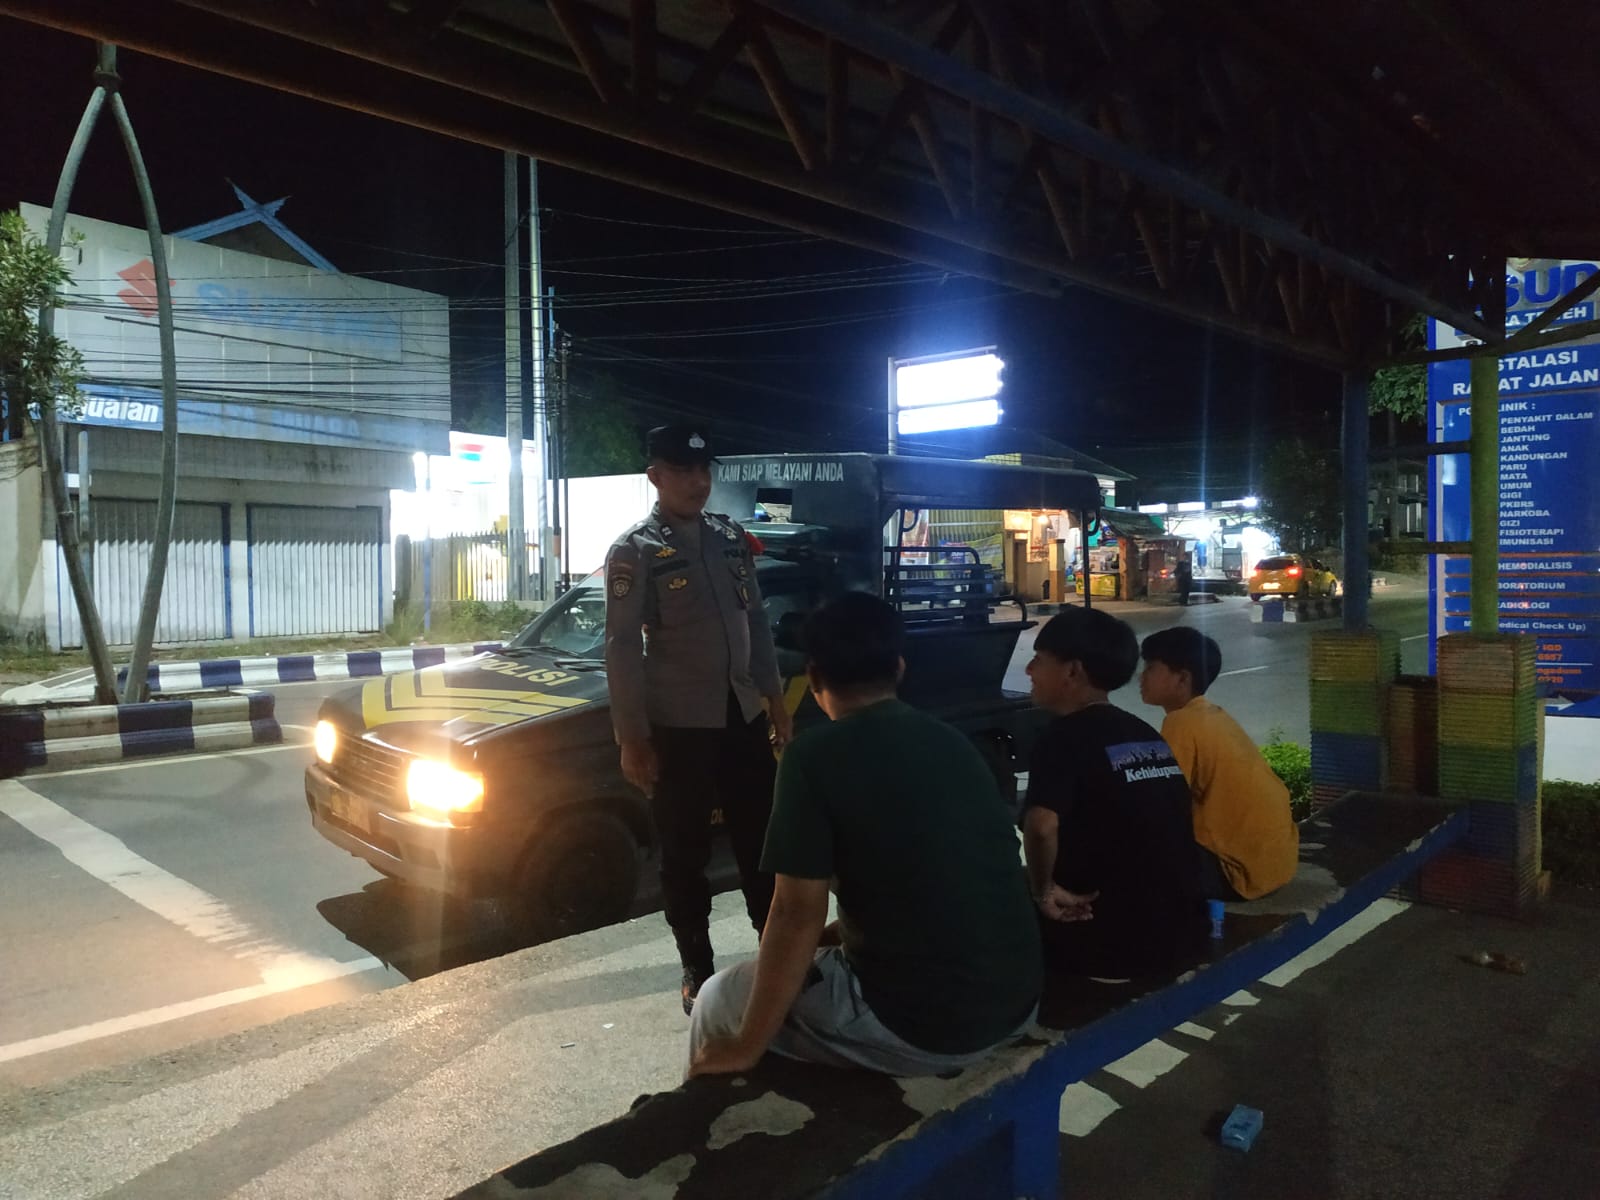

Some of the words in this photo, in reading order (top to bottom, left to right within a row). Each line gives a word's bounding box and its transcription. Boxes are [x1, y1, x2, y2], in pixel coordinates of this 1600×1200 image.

[1498, 350, 1579, 372] STALASI
[1528, 368, 1599, 389] JALAN
[1500, 414, 1552, 424] PENYAKIT
[1555, 412, 1593, 421] DALAM
[1500, 425, 1536, 434] BEDAH
[1500, 434, 1551, 443] JANTUNG
[1500, 444, 1530, 453] ANAK
[1500, 452, 1568, 462] KANDUNGAN
[1500, 463, 1527, 471] PARU
[717, 464, 741, 483] KAMI
[742, 463, 763, 482] SIAP
[765, 462, 813, 482] MELAYANI
[815, 462, 844, 482] ANDA
[1500, 482, 1532, 490] UMUM
[1500, 509, 1550, 517] NARKOBA
[1499, 528, 1564, 536] FISIOTERAPI
[1499, 538, 1554, 546] IMUNISASI
[1498, 561, 1573, 571] HEMODIALISIS
[1532, 621, 1565, 630] Check
